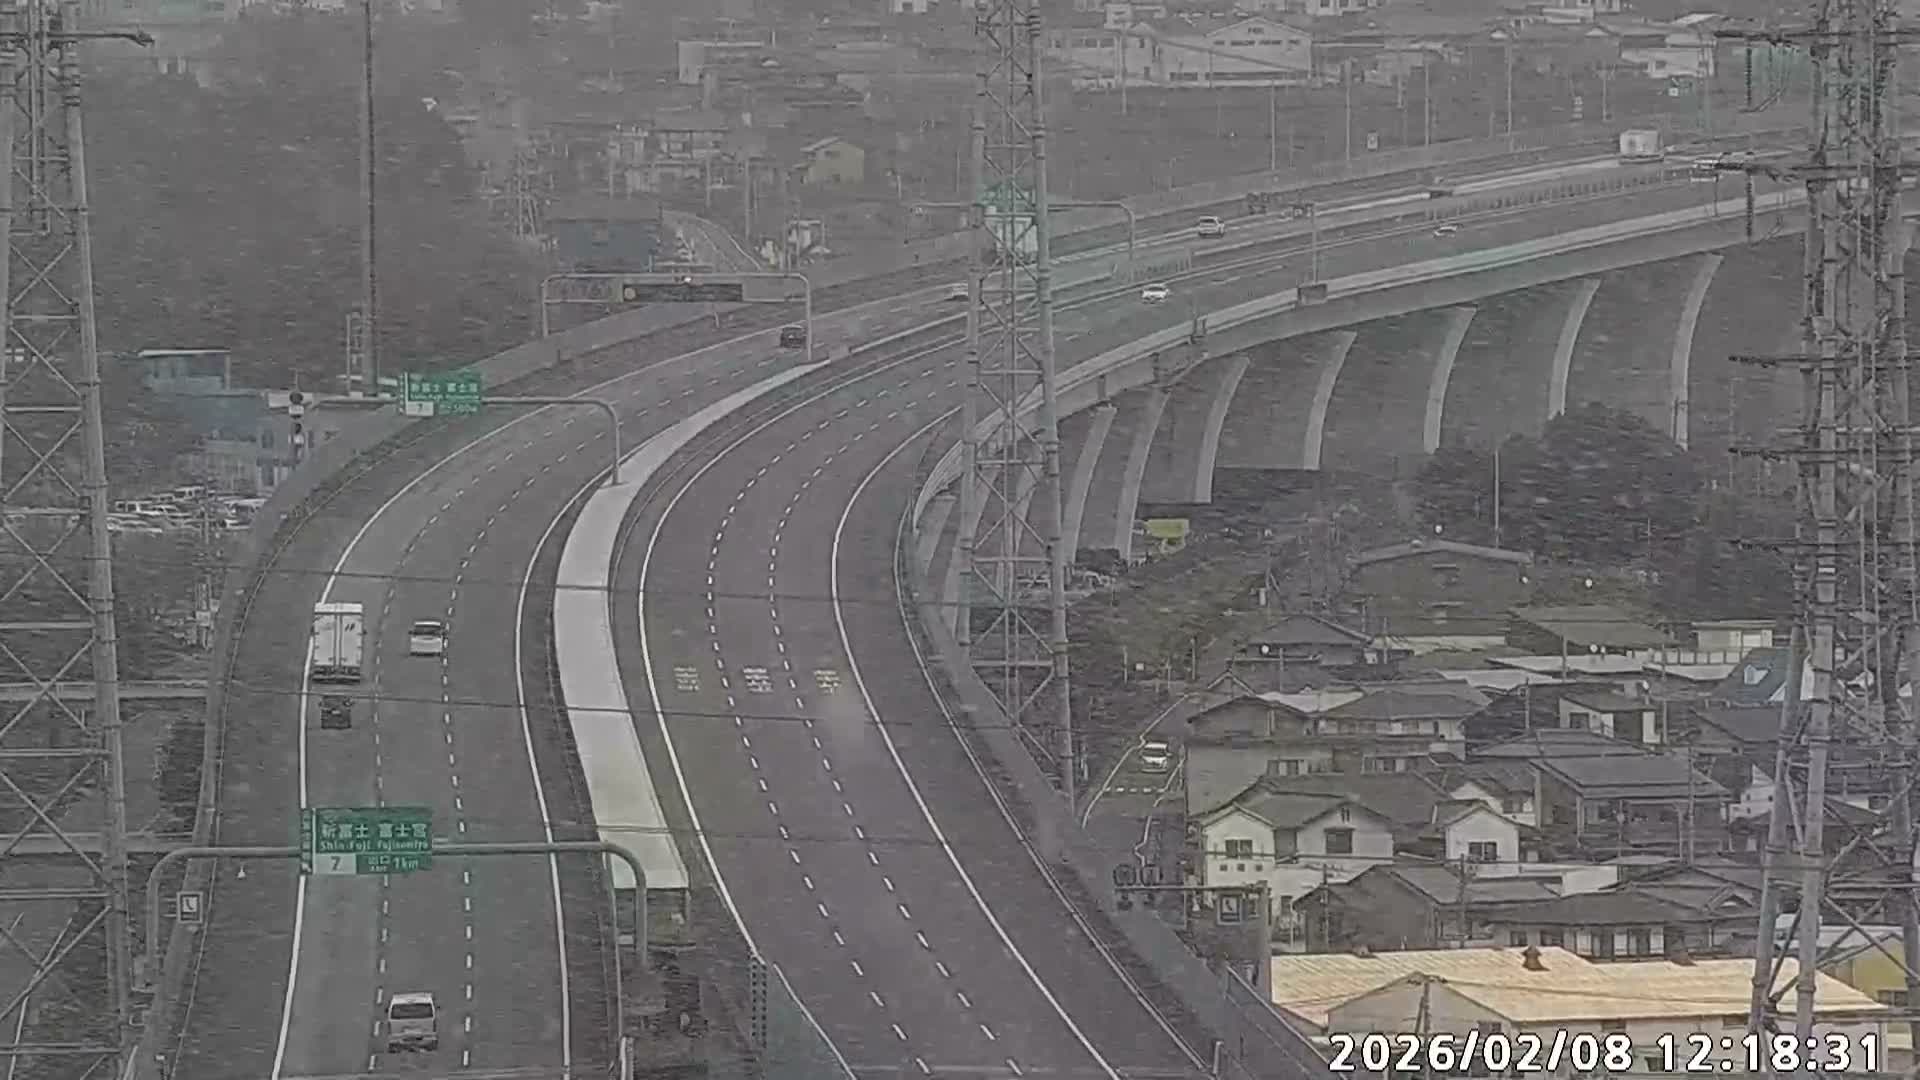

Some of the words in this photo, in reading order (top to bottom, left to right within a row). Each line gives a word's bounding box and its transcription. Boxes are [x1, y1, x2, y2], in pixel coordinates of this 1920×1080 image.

[321, 822, 368, 838] 新富士
[379, 823, 427, 838] 富士宮
[330, 856, 342, 871] 7
[393, 857, 419, 870] 1km
